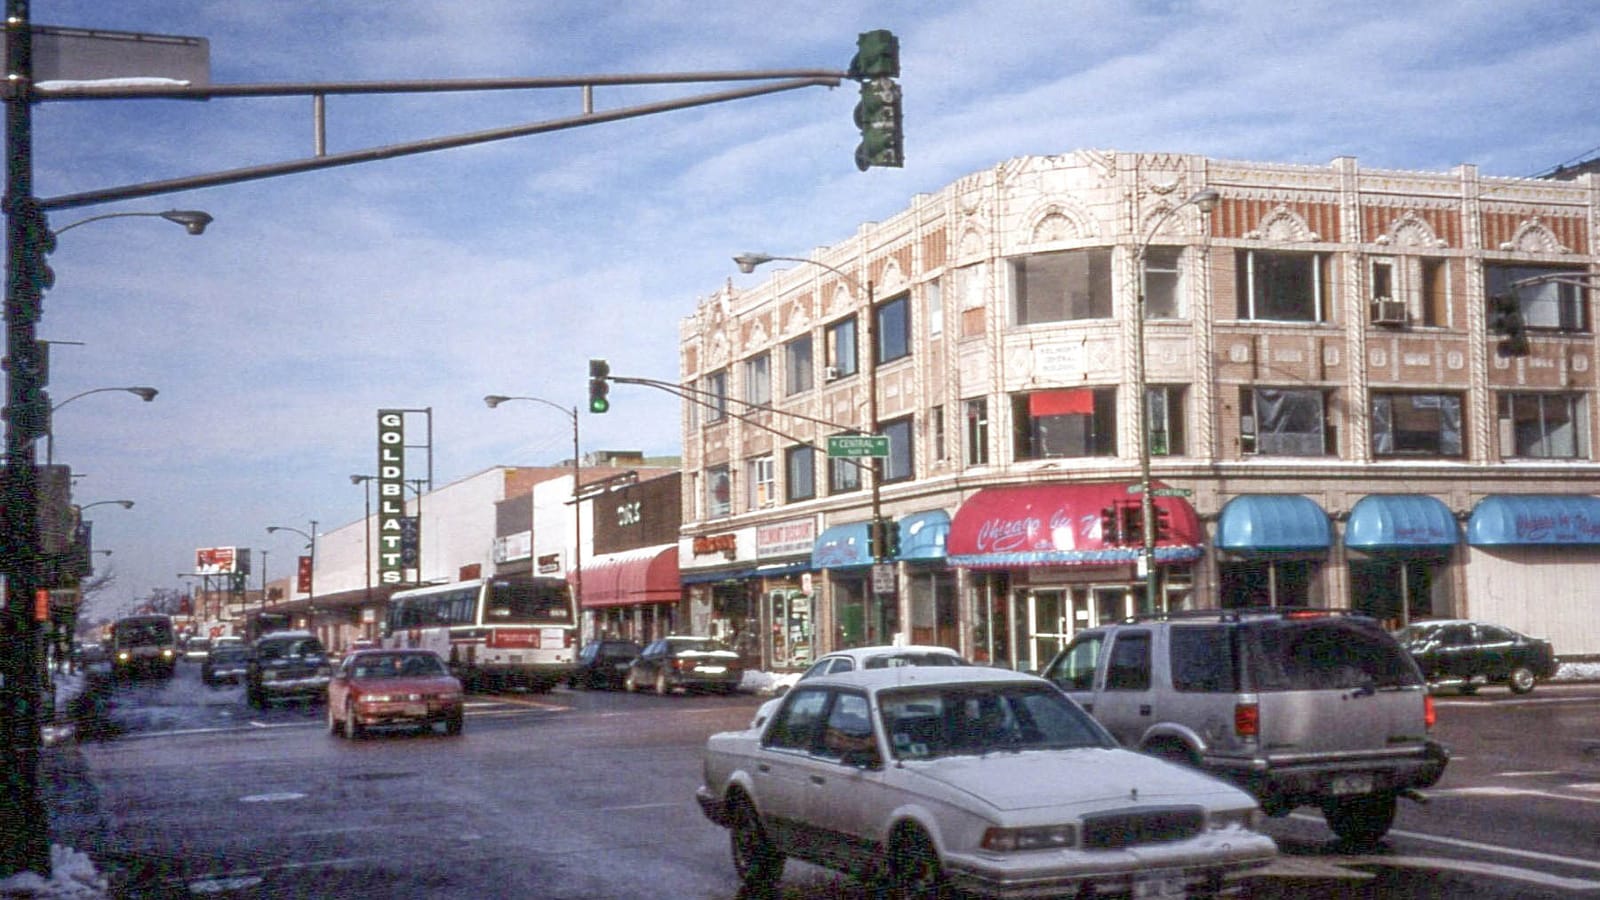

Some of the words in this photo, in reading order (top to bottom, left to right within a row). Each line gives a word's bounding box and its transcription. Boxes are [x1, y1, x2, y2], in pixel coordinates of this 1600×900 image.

[840, 439, 874, 449] CENTRAL
[381, 414, 402, 583] GOLDBLATTS
[977, 516, 1042, 550] Chicago
